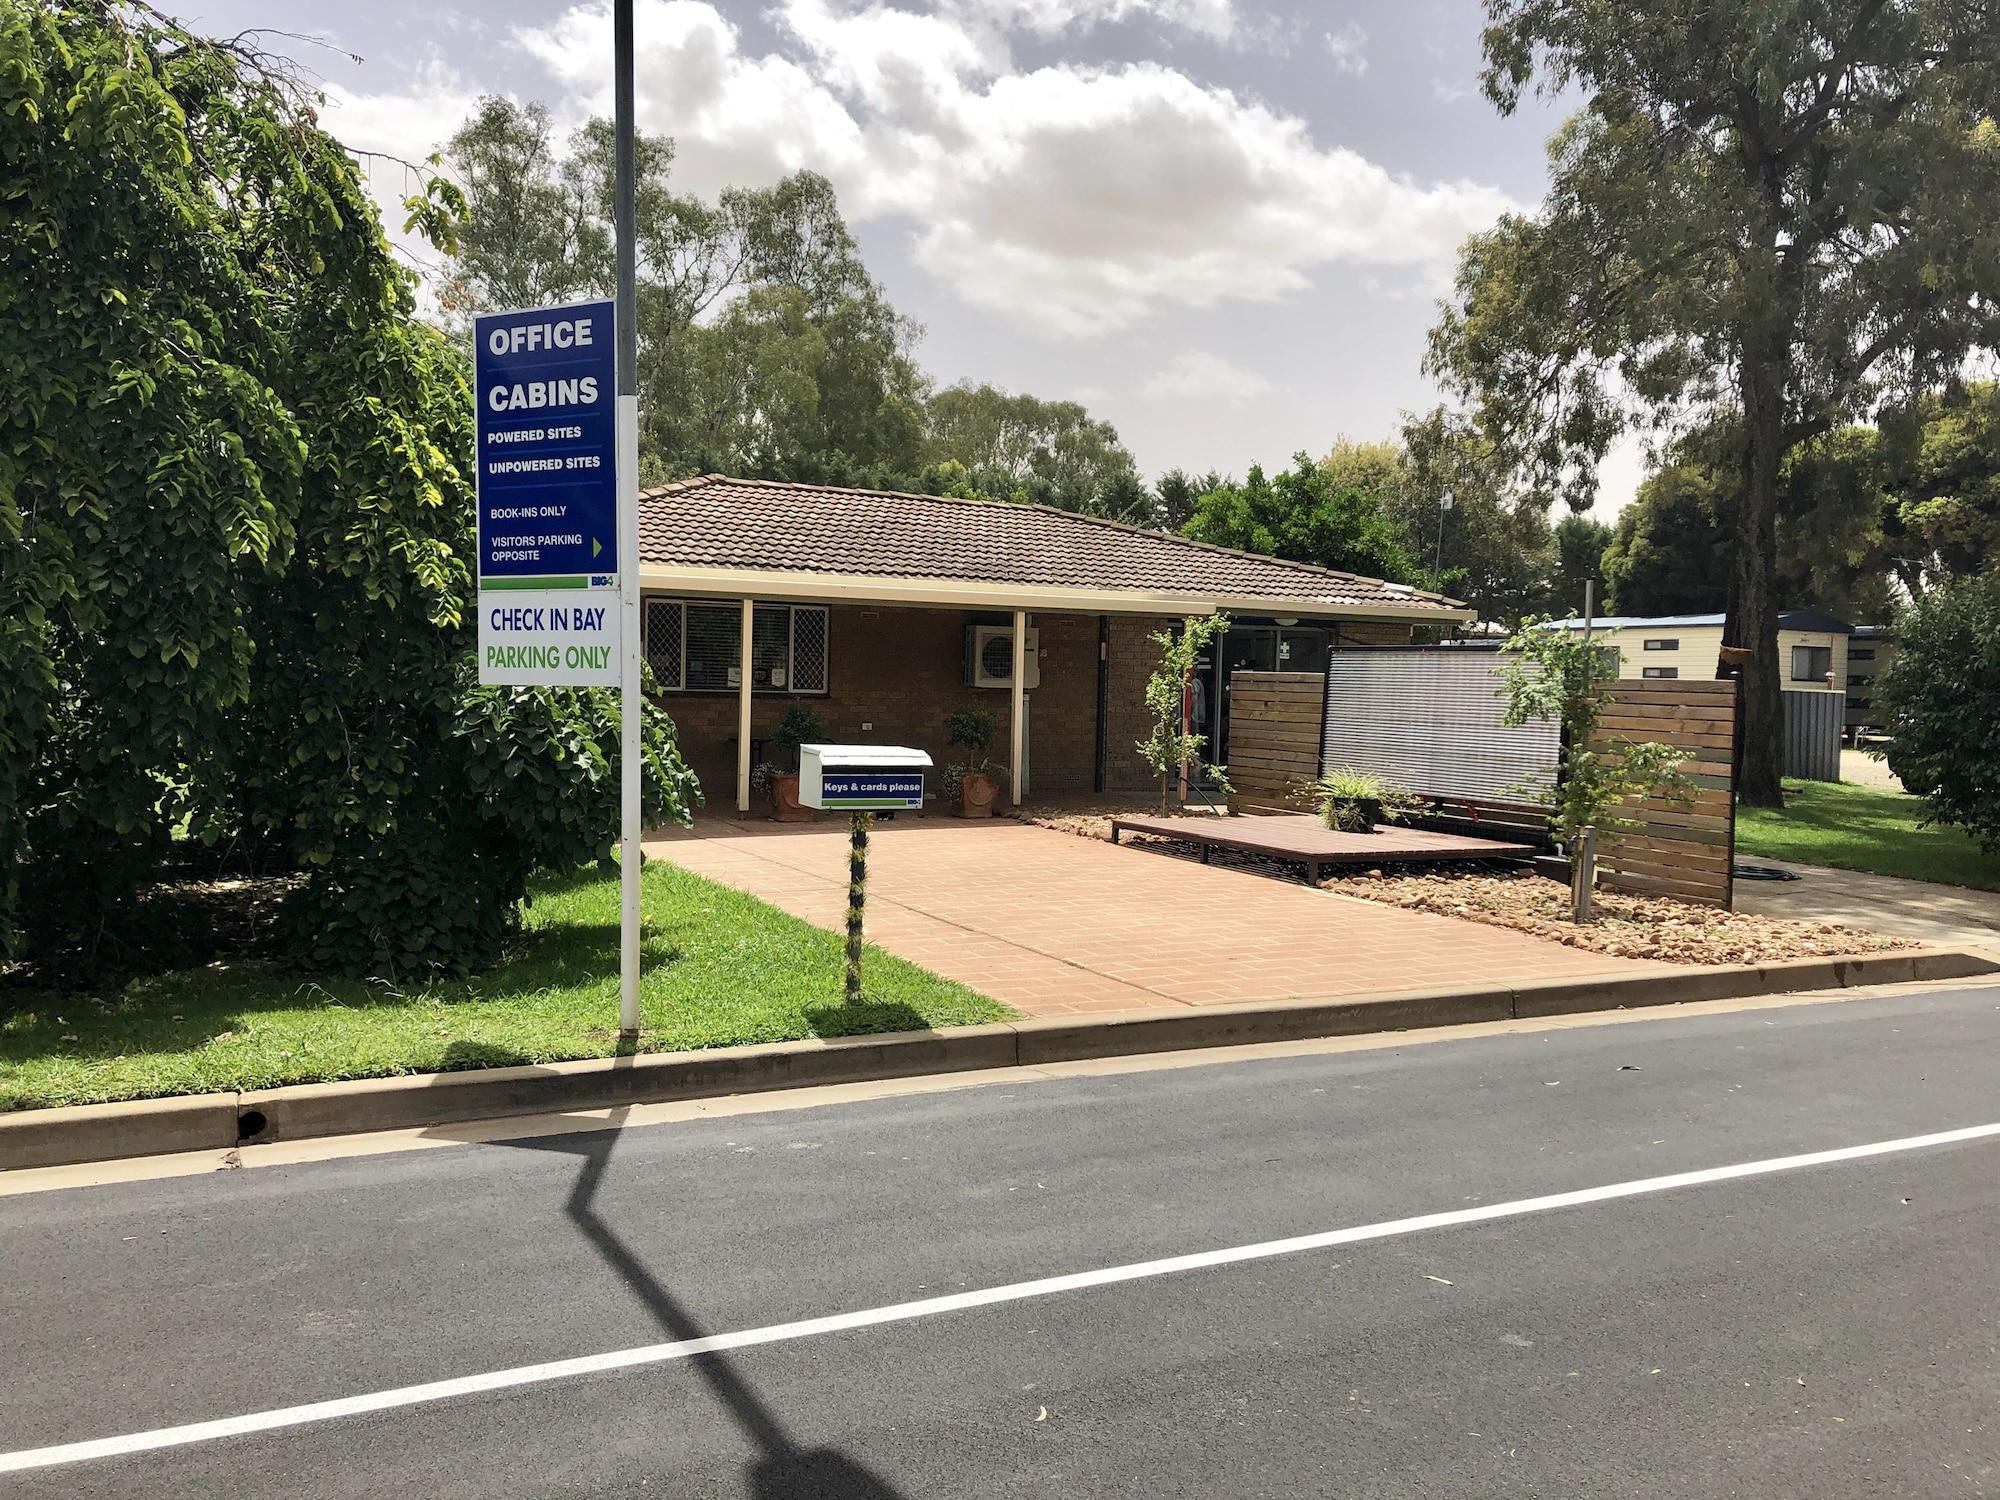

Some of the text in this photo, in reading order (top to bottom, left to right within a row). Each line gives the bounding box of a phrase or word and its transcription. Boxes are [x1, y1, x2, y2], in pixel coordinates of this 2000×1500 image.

[489, 319, 592, 355] OFFICE
[489, 377, 598, 412] CABINS
[488, 426, 582, 444] POWERED SITES
[489, 456, 600, 474] UNPOWERED SITES
[491, 506, 567, 519] BOOK-INS ONLY
[491, 534, 582, 547] VISITORS PARKING
[492, 550, 540, 561] OPPOSITE
[591, 576, 613, 586] BIG4
[491, 608, 605, 631] CHECK IN BAY
[487, 646, 611, 669] PARKING ONLY
[824, 783, 920, 792] Keys & cards please
